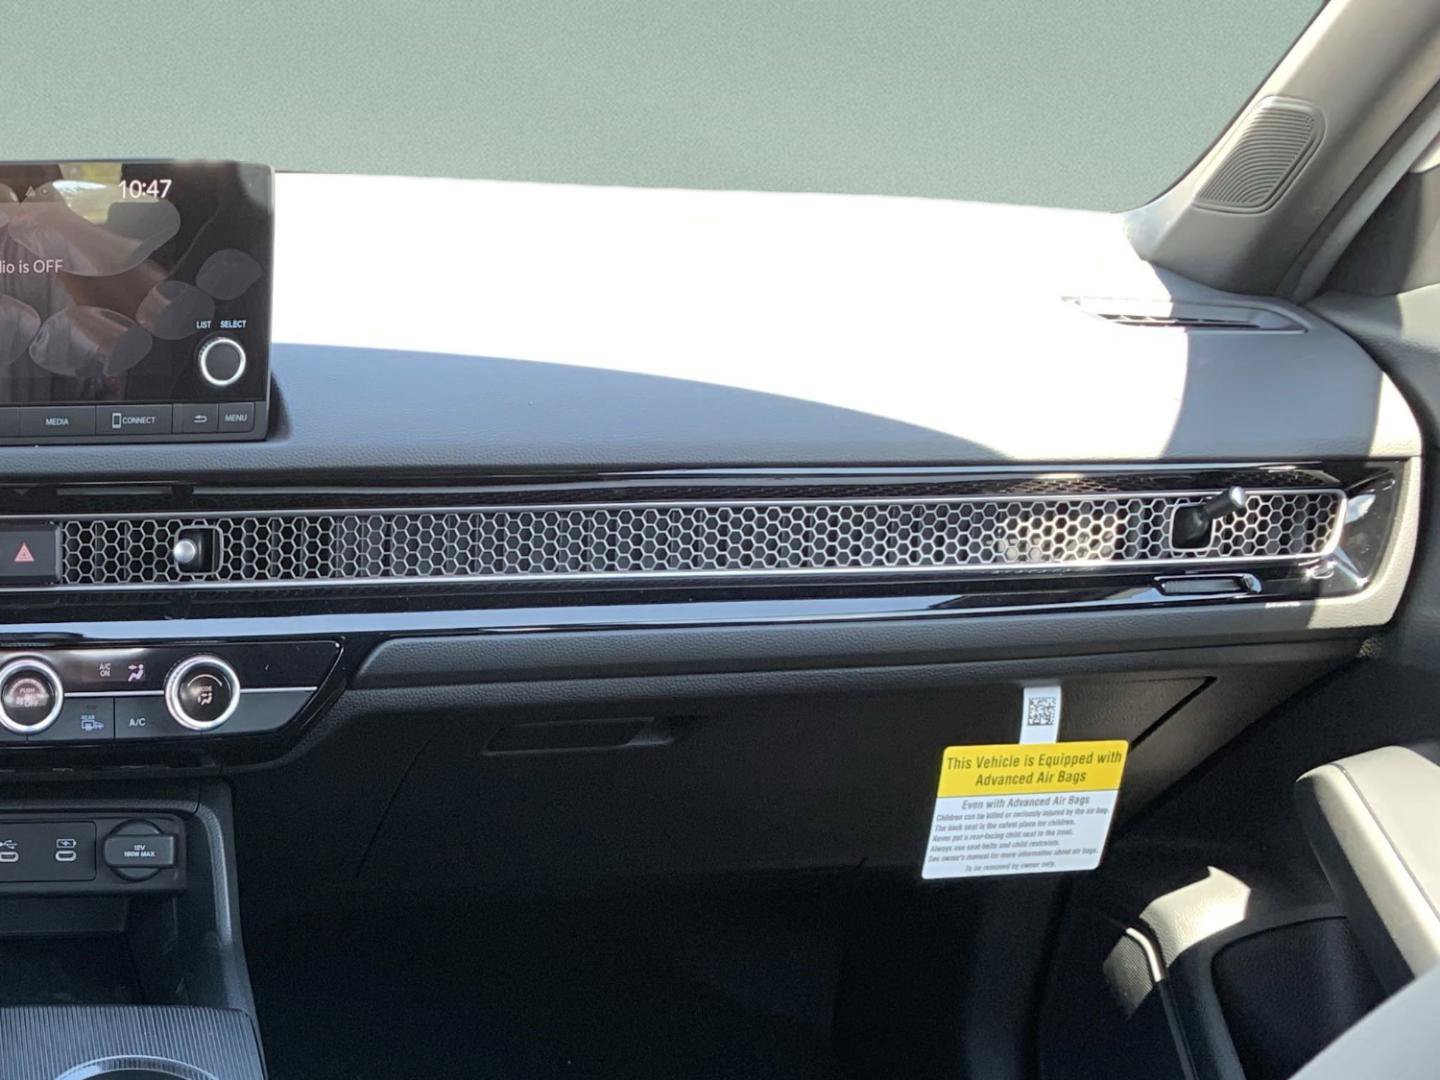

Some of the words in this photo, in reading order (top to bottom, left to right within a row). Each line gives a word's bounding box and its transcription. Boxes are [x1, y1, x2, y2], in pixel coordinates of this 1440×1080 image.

[118, 179, 173, 199] 10:47
[18, 259, 30, 274] is
[33, 259, 63, 274] OFF
[196, 320, 211, 329] LIST
[220, 319, 247, 329] SELECT
[46, 417, 69, 427] MEDIA
[122, 416, 156, 425] CONNECT
[225, 413, 247, 422] MENU
[129, 718, 147, 727] A/C
[947, 757, 972, 770] This
[976, 755, 1020, 768] Vehicle
[1024, 754, 1035, 766] is
[1038, 752, 1094, 768] Equipped
[1097, 751, 1123, 764] with
[975, 771, 1033, 787] Advanced
[1036, 772, 1054, 784] Air
[1057, 770, 1087, 785] Bags
[961, 800, 984, 810] Even
[985, 799, 1005, 809] with
[1007, 797, 1051, 808] Advanced
[1052, 796, 1067, 805] Air
[1068, 795, 1091, 806] Bags
